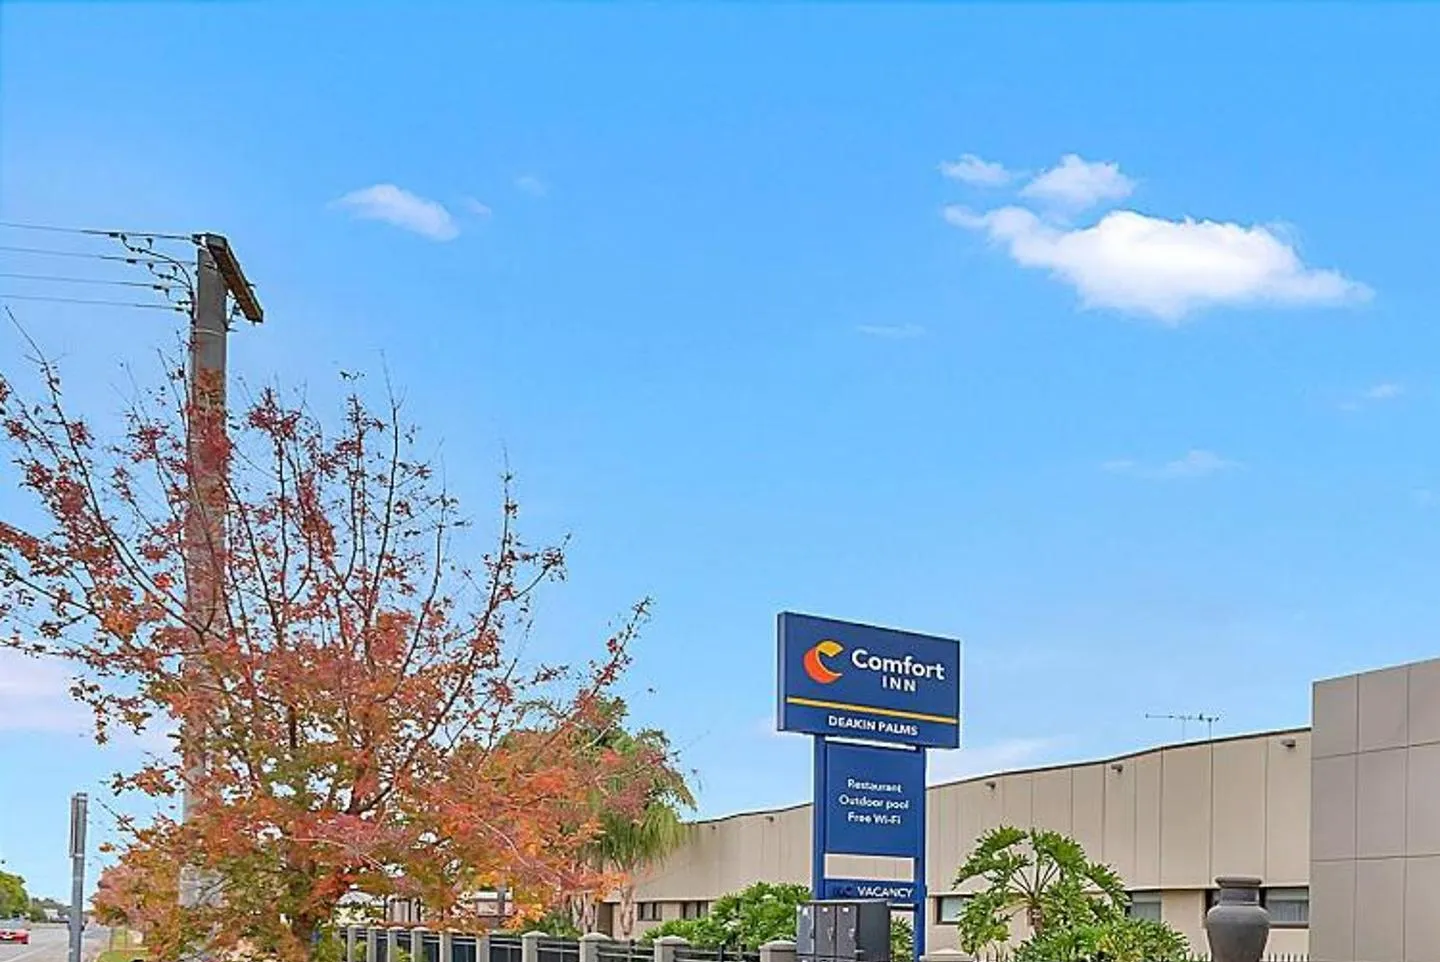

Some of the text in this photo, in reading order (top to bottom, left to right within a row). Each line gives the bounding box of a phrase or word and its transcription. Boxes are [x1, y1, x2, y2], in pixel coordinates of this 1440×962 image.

[851, 648, 946, 681] Comfort
[882, 675, 917, 692] INN
[828, 715, 919, 736] DEAKIN PALMS
[847, 778, 902, 793] Restaurant
[838, 793, 909, 810] Outdoor pool
[847, 811, 901, 825] Free Wi-Fi
[857, 885, 913, 898] VACANCY
